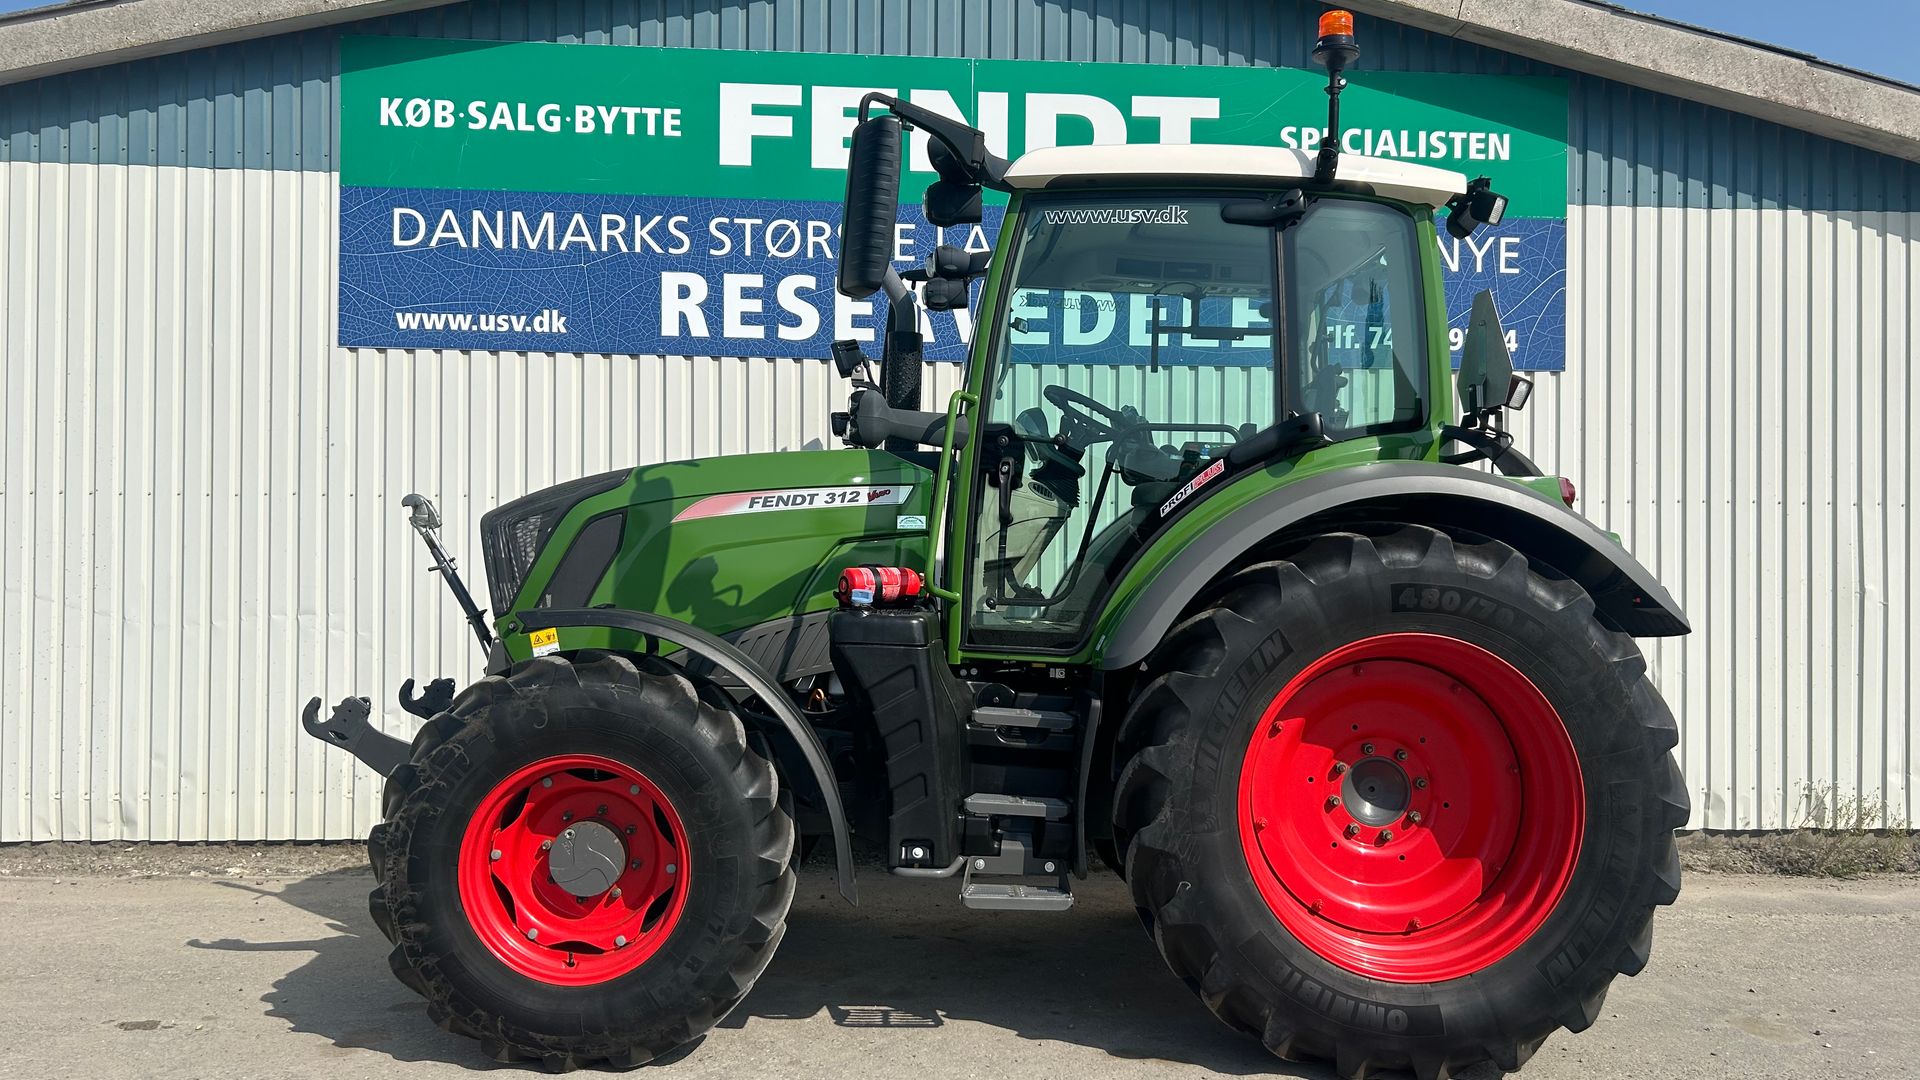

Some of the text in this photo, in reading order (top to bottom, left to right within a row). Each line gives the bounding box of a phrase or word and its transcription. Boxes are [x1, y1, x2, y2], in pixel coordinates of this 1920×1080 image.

[719, 82, 1220, 172] FENDT
[1280, 126, 1511, 160] SPCIALISTEN
[1045, 205, 1189, 224] www.usv.dk
[392, 207, 690, 256] DANMARKS
[709, 217, 915, 261] STØRE
[396, 311, 567, 333] www.usv.dk
[748, 493, 819, 509] FENDT
[824, 490, 861, 504] 312
